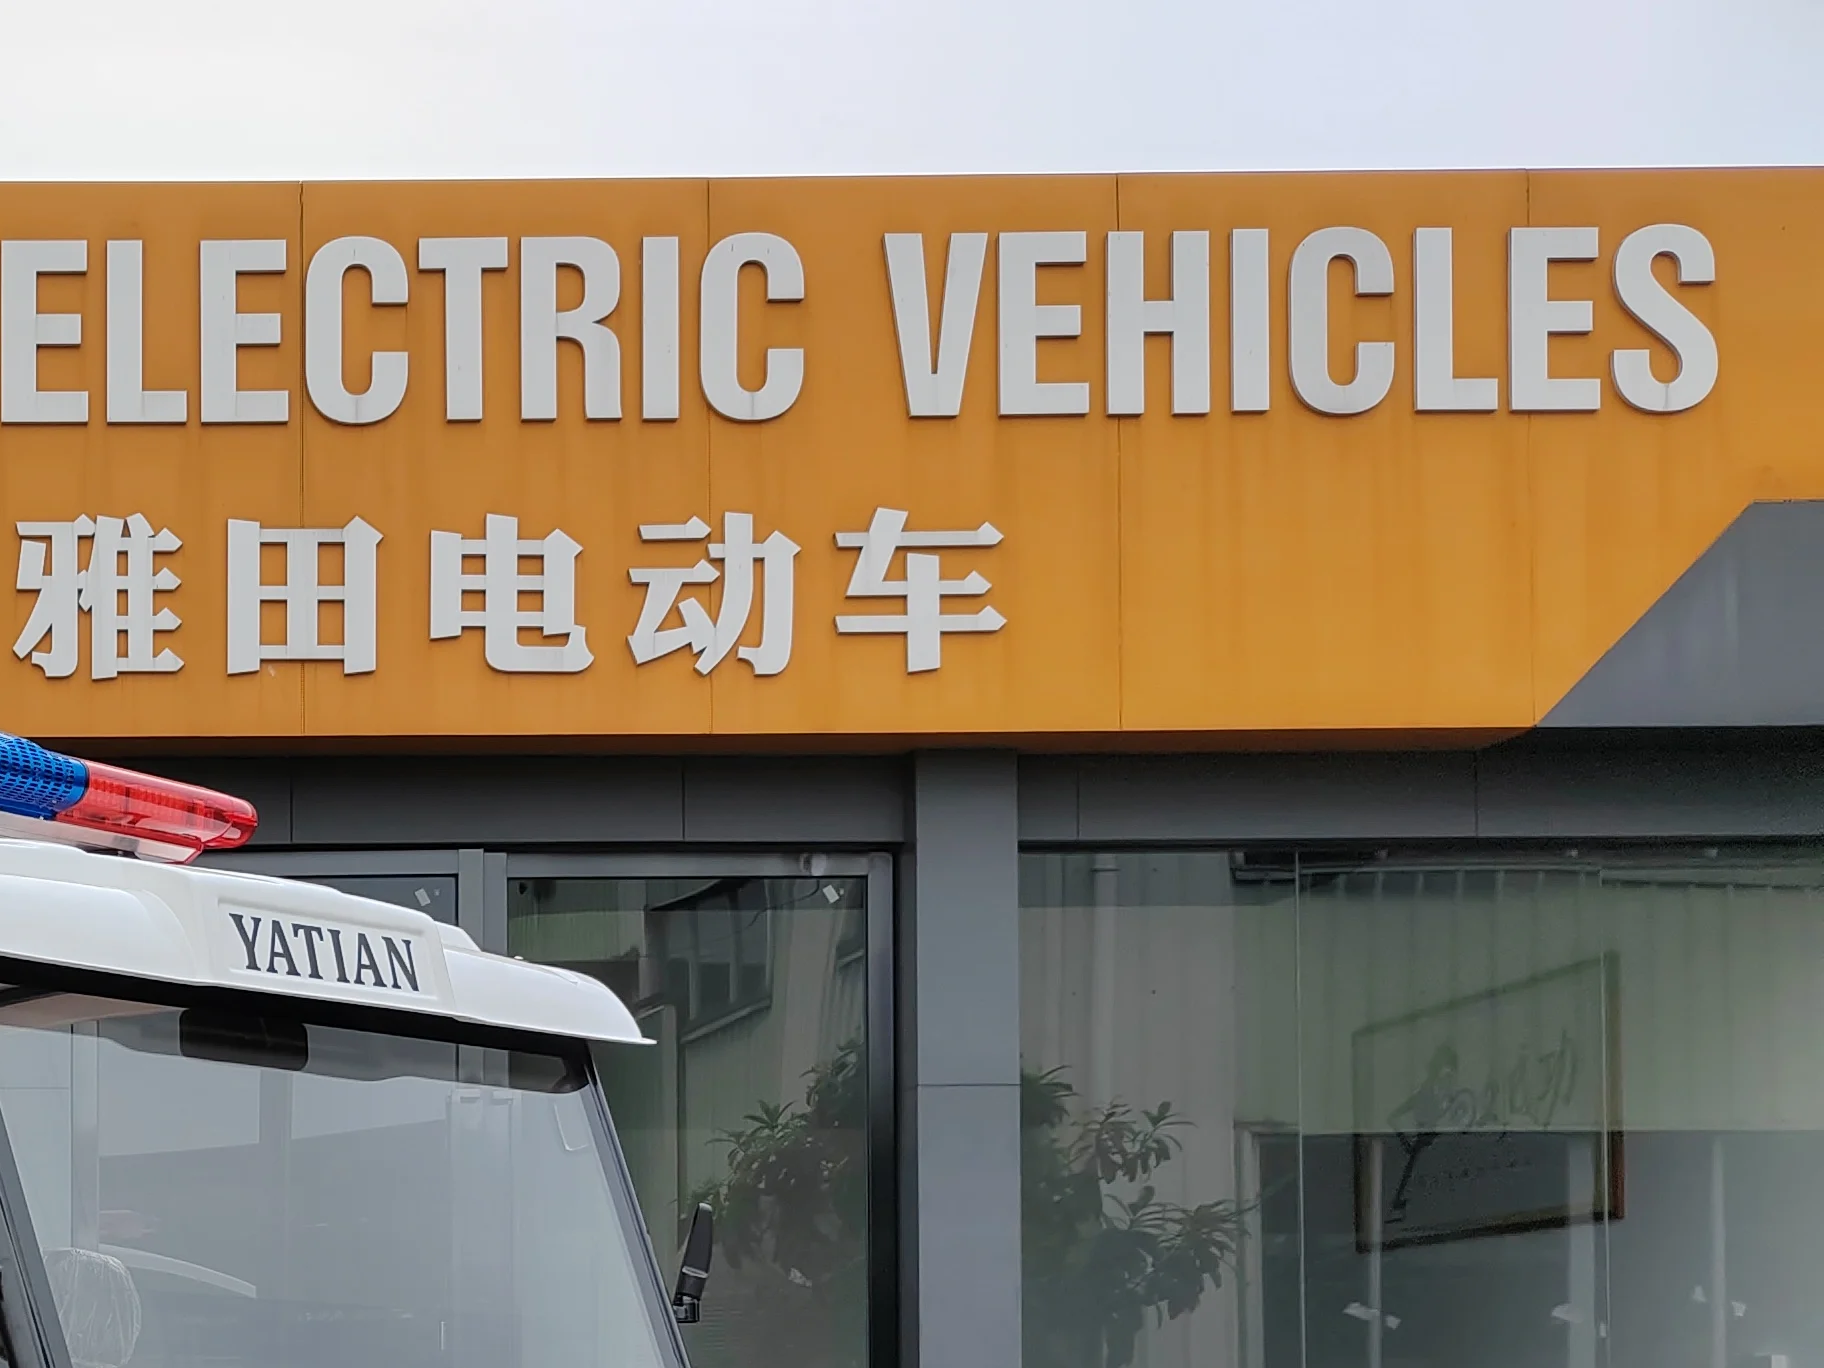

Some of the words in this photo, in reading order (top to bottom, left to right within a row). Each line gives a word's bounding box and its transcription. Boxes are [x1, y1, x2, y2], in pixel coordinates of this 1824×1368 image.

[0, 231, 806, 425] ELECTRIC
[883, 223, 1719, 420] VEHICLES
[12, 507, 1007, 681] 雅田电动车
[228, 912, 421, 993] YATIAN
